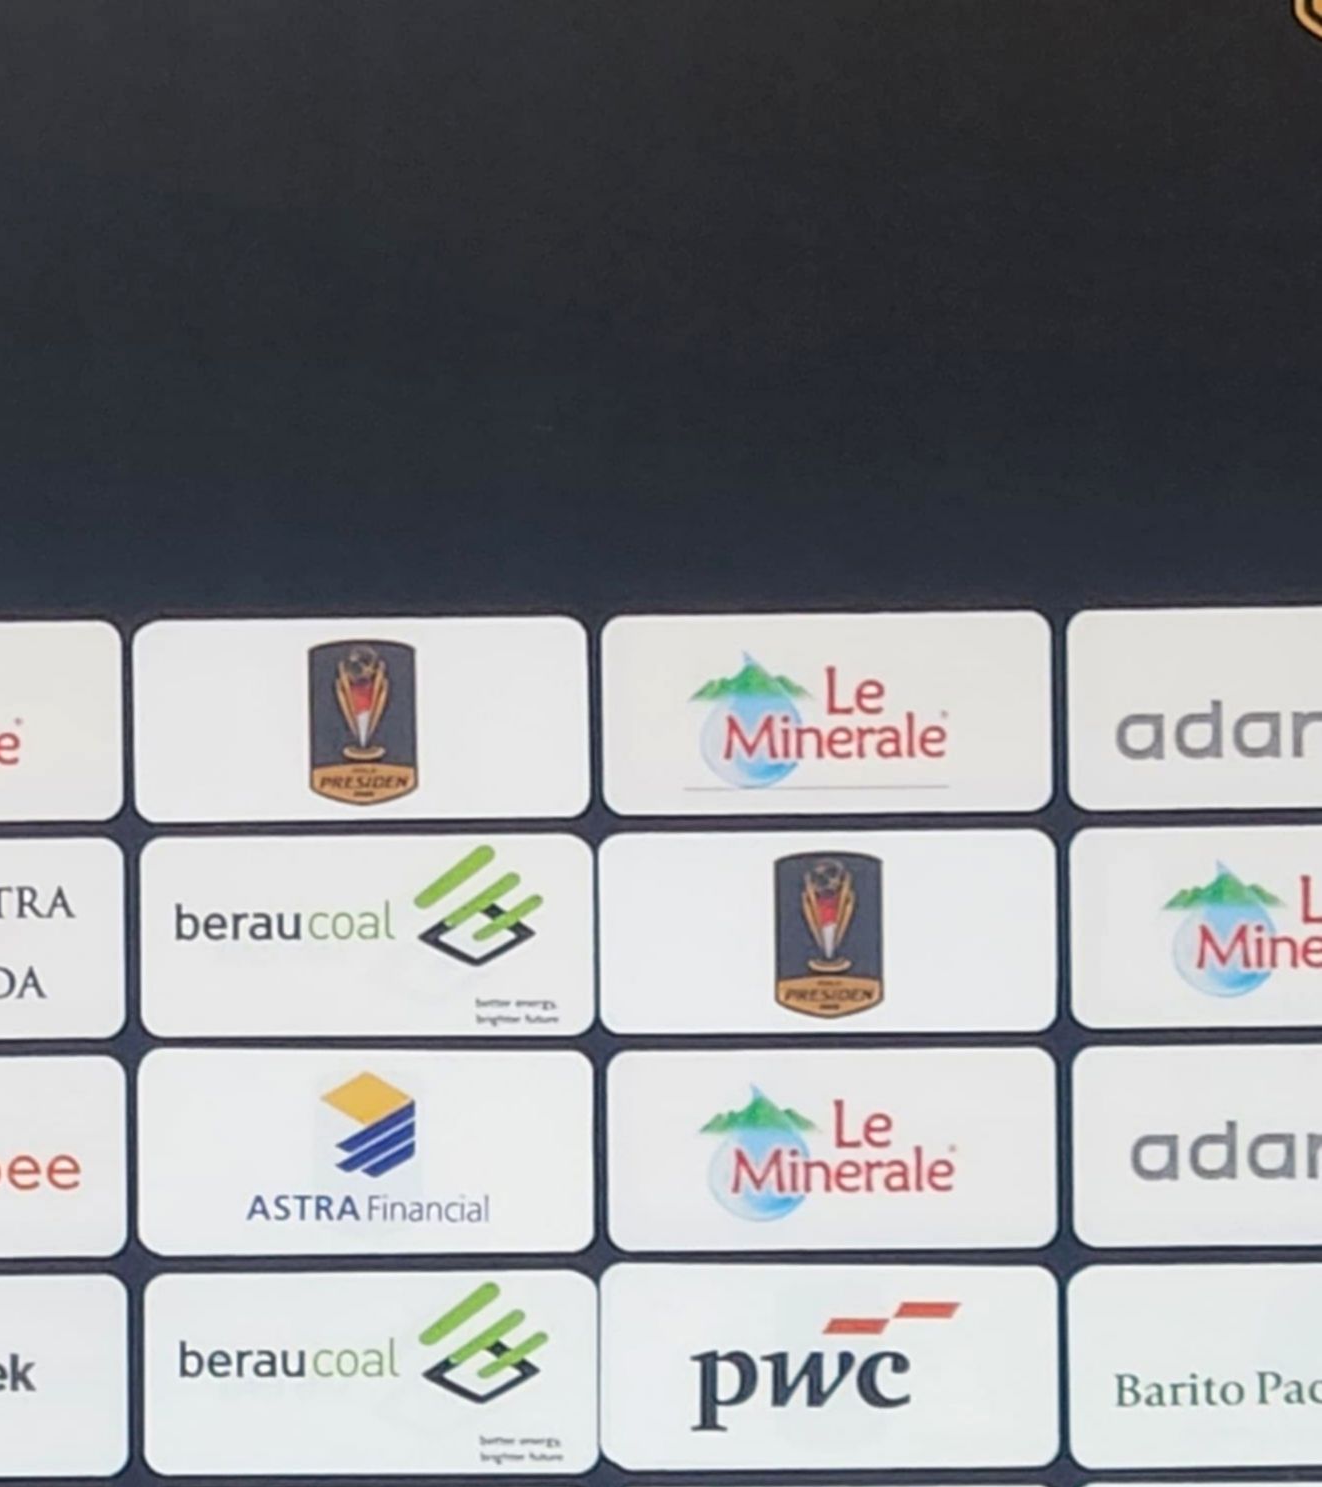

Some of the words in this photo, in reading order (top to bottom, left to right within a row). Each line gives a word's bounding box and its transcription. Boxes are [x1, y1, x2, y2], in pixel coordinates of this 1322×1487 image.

[825, 666, 884, 716] Le
[722, 713, 946, 759] Minerale
[834, 1101, 892, 1149] Le
[732, 1147, 953, 1192] Minerale
[247, 1195, 361, 1221] ASTRA
[368, 1195, 489, 1222] Financial
[690, 1350, 911, 1432] pwc
[1115, 1373, 1245, 1407] Barito
